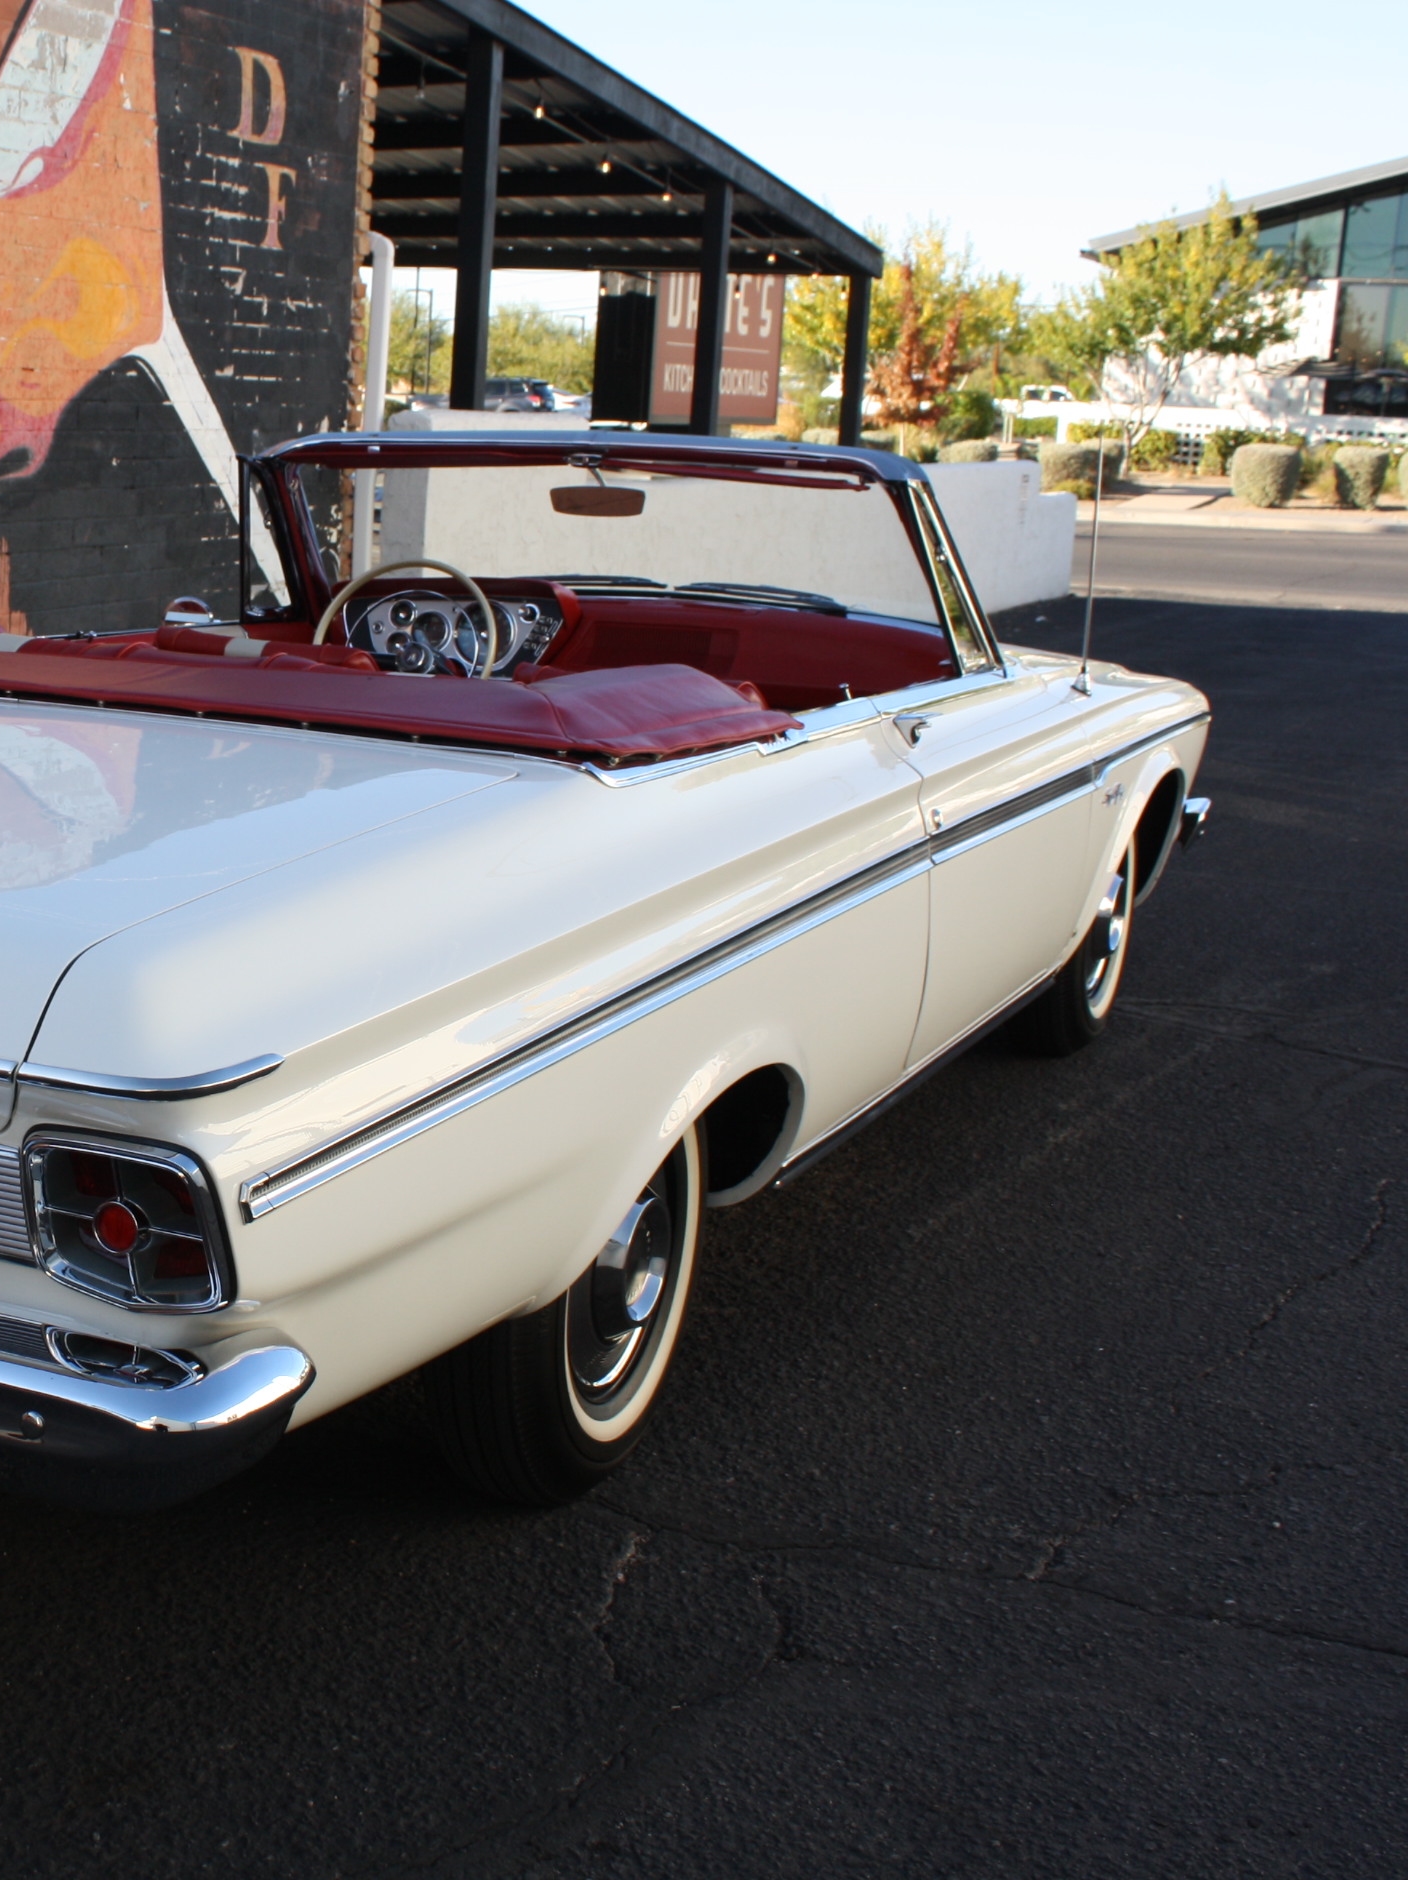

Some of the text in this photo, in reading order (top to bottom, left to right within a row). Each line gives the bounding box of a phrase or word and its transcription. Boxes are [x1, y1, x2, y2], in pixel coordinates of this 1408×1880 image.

[227, 46, 286, 146] D
[254, 162, 297, 250] F
[718, 367, 769, 397] COCKTAILS
